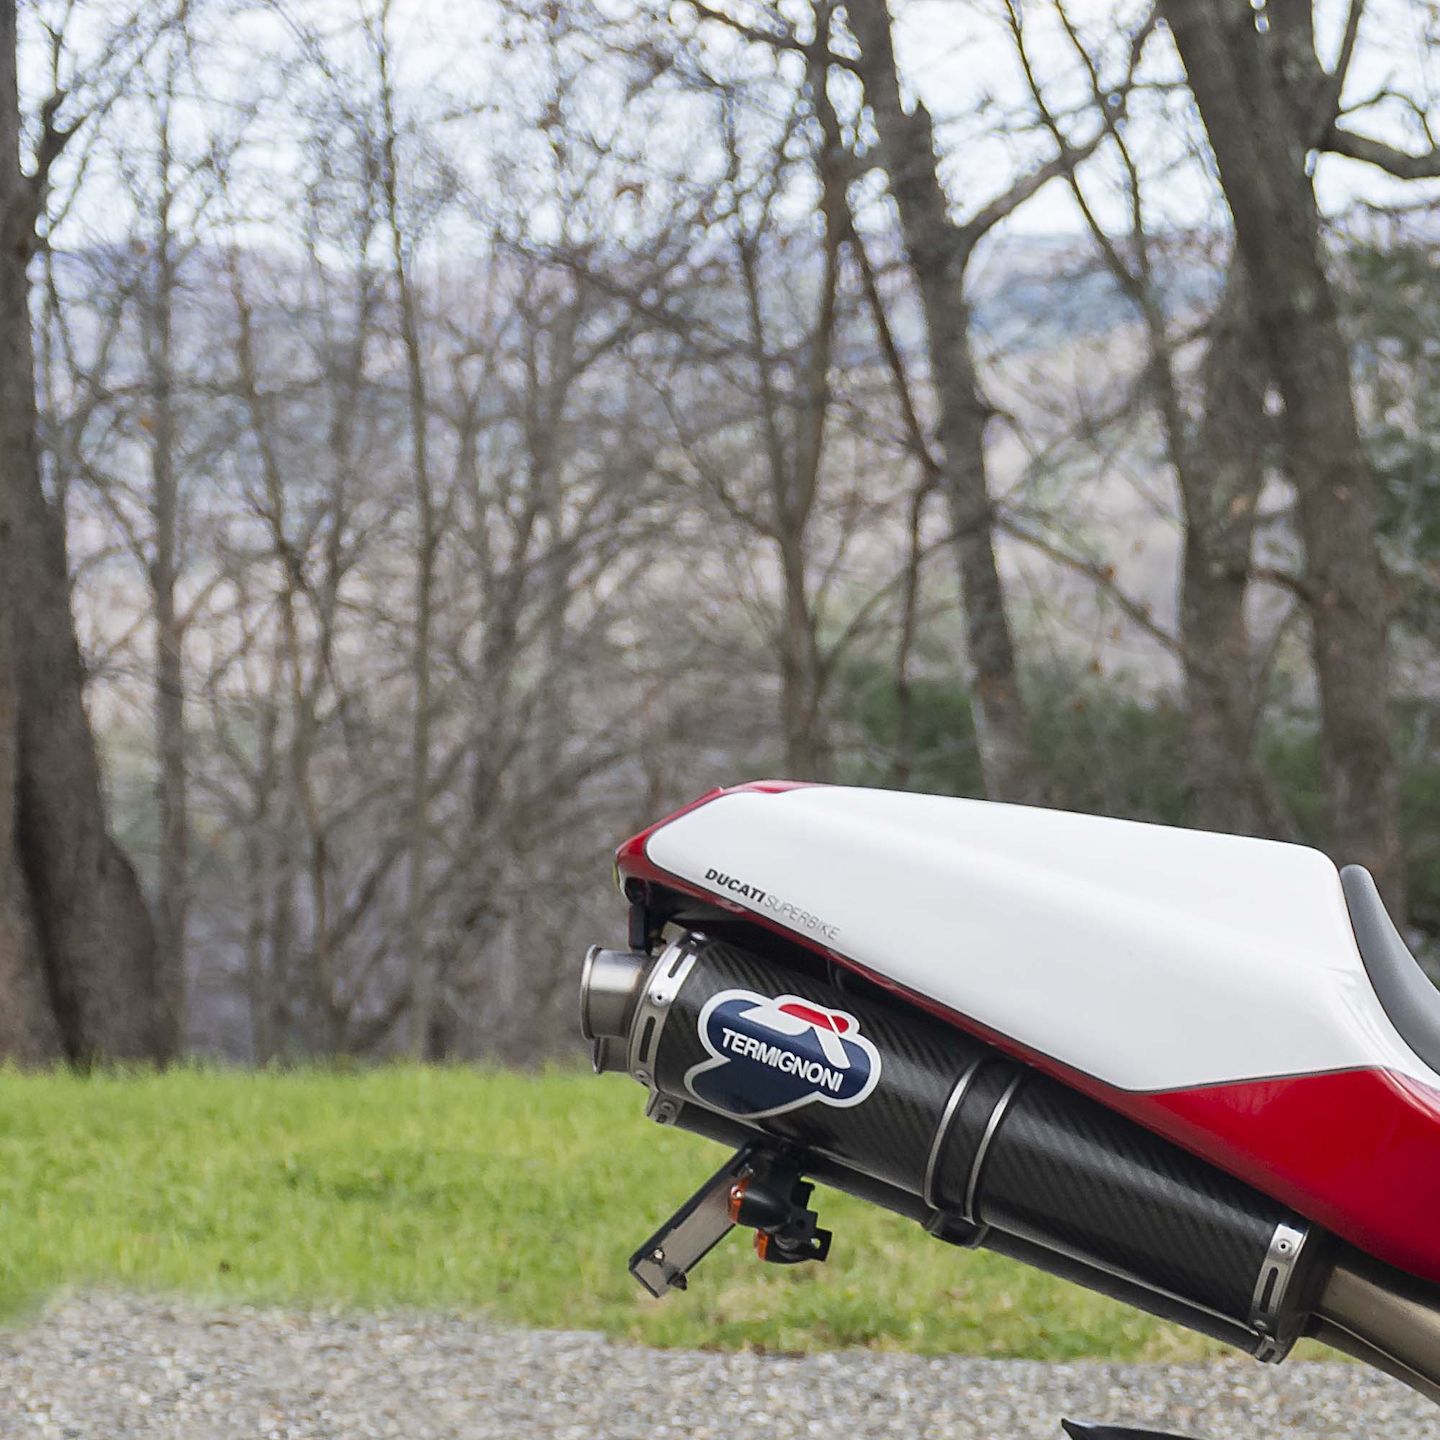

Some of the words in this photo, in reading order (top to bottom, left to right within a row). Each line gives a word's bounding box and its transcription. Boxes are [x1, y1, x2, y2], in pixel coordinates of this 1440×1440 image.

[704, 867, 766, 903] DUCATI
[763, 894, 841, 941] SUPERBIKE
[721, 1027, 844, 1093] TERMIGNONI
